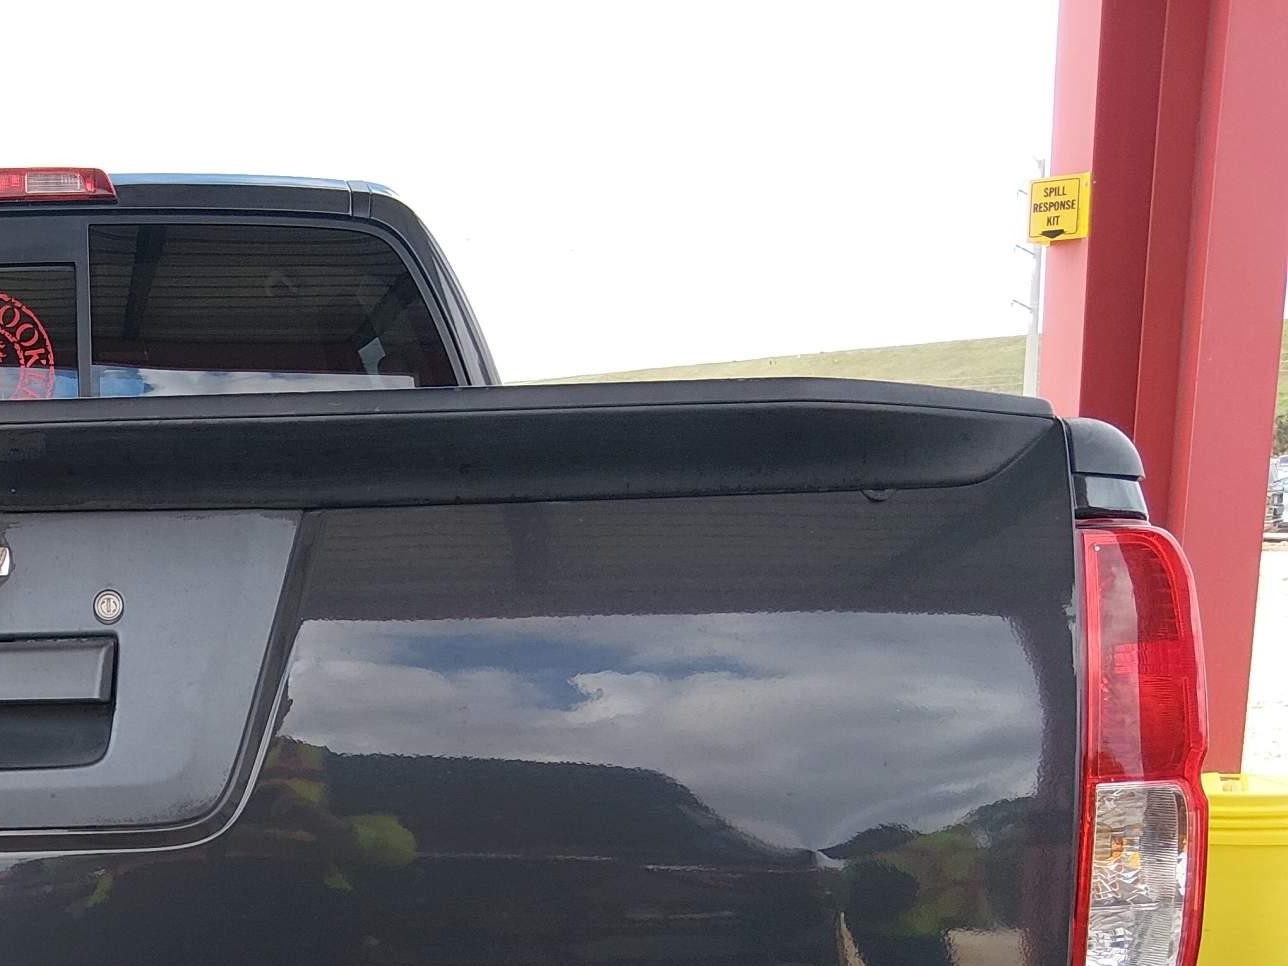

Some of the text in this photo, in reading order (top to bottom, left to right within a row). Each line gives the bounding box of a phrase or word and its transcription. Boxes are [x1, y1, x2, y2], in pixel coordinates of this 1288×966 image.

[1043, 186, 1067, 198] SPILL
[1033, 199, 1076, 213] RESPONSE
[1046, 215, 1060, 227] KIT
